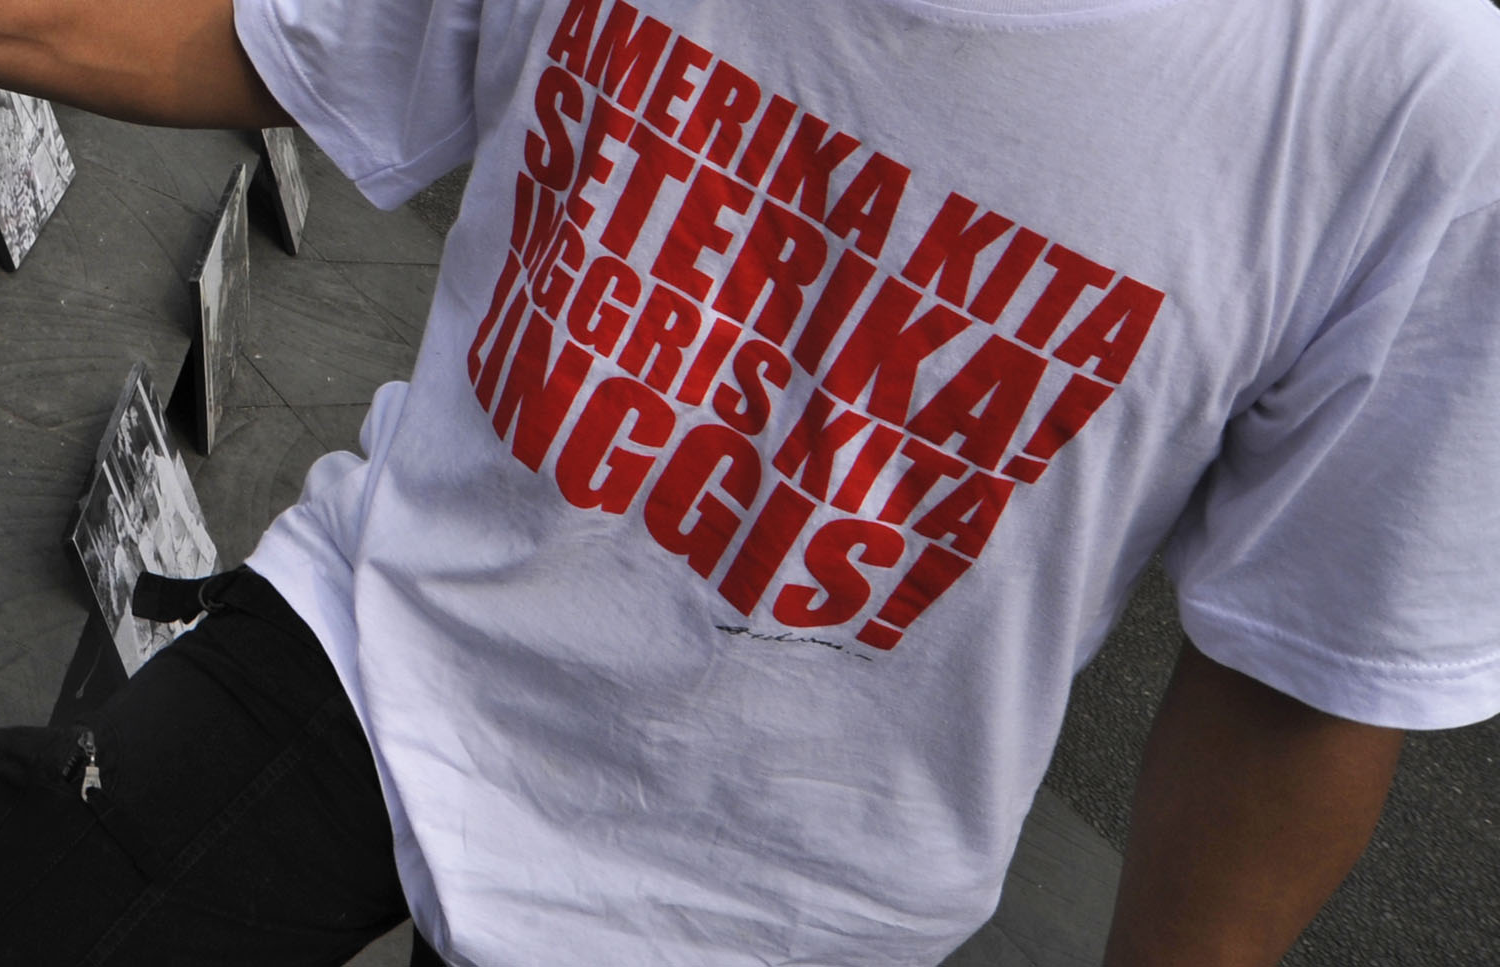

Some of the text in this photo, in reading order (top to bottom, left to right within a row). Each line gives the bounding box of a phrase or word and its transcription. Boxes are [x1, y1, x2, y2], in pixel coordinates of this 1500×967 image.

[466, 250, 973, 651] LINGGIS!
[510, 171, 1016, 559] INGGRIS KITA
[524, 65, 1115, 484] SETERIKA!
[900, 191, 1165, 383] KITA
